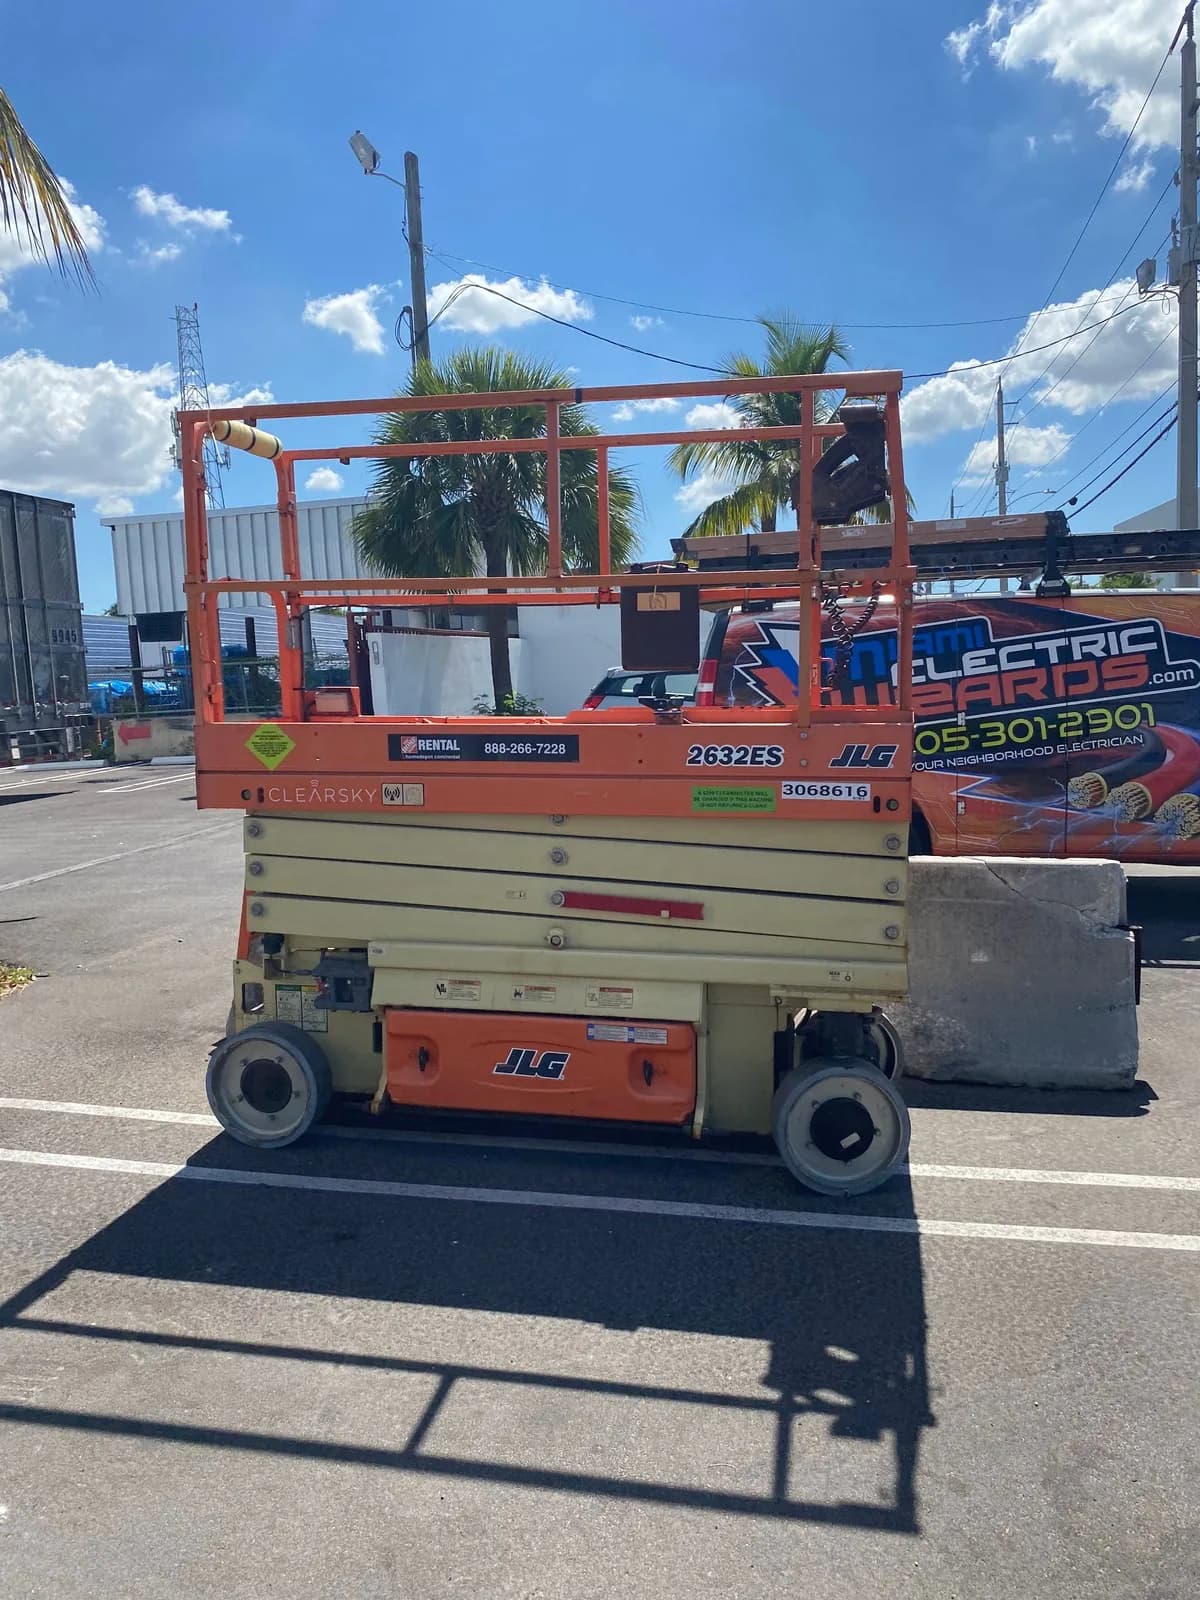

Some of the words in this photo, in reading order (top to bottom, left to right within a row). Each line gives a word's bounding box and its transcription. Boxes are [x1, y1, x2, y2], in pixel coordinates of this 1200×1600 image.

[890, 625, 1156, 687] ELECTRIC
[915, 702, 1157, 755] 05-301-2901
[418, 739, 461, 751] RENTAL
[484, 744, 567, 755] 888-266-7228
[686, 744, 784, 767] 2632ES
[828, 745, 898, 768] JLG
[946, 745, 1053, 768] NEIGHBORHOOD
[1055, 734, 1142, 753] ELECTRICIAN
[268, 787, 376, 803] CLEARSKY
[783, 784, 868, 798] 3068616
[492, 1047, 571, 1080] JLG
